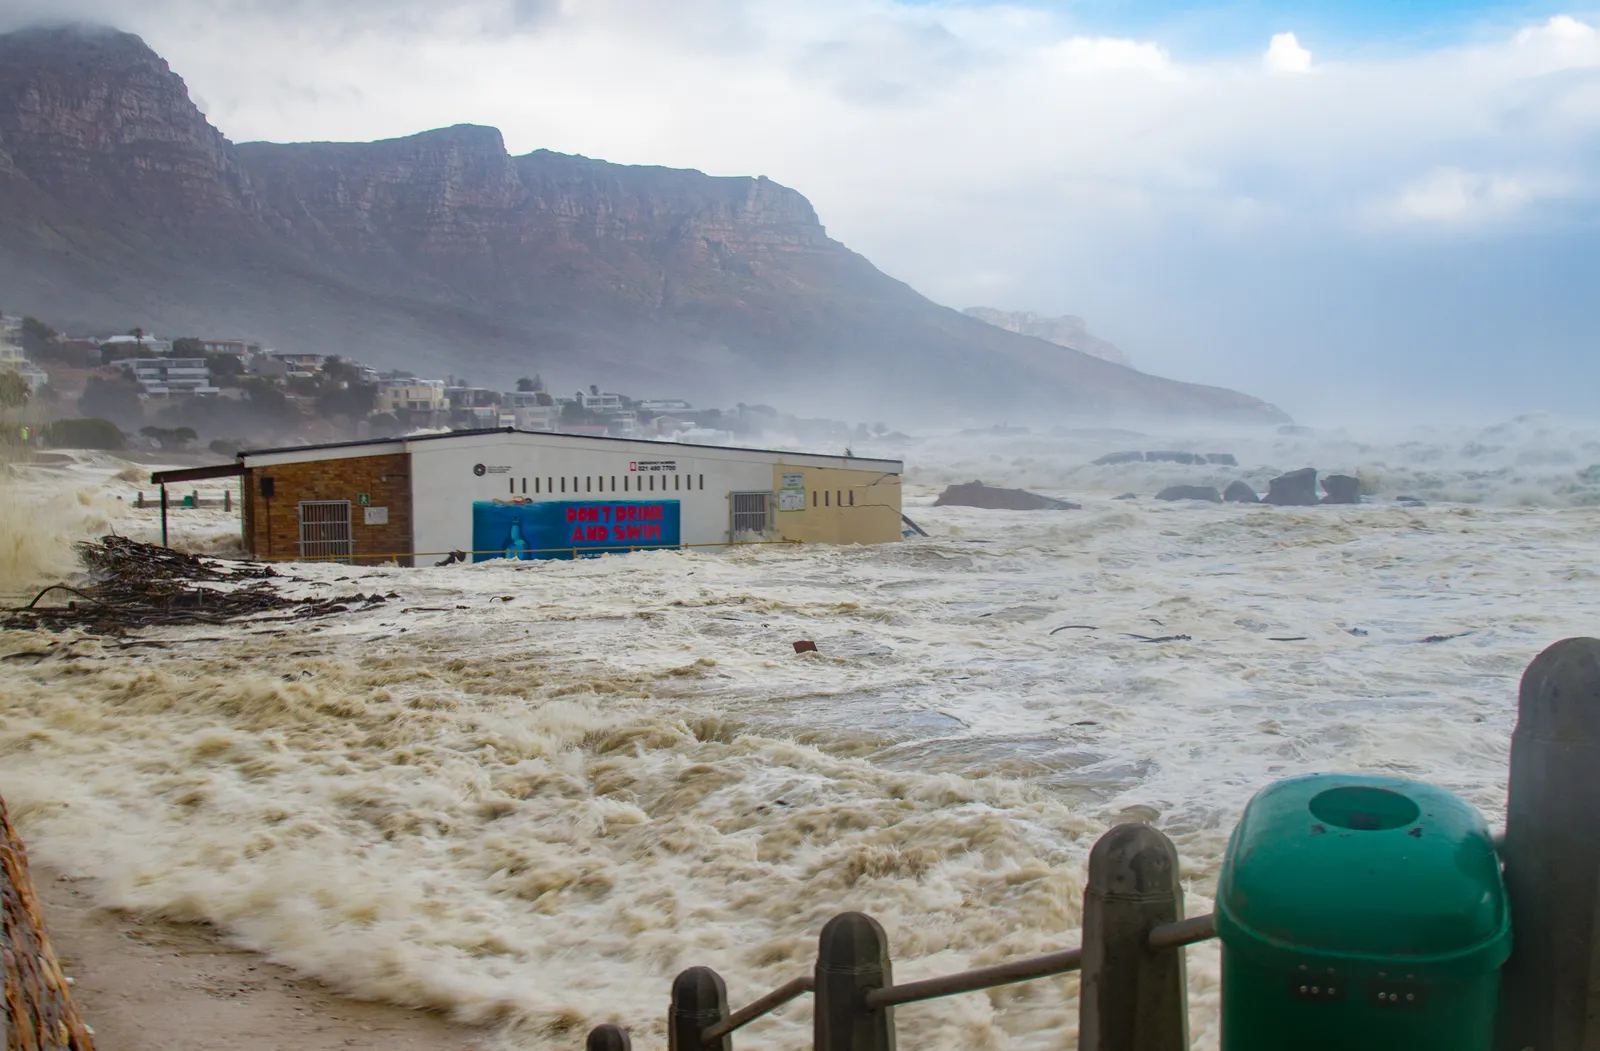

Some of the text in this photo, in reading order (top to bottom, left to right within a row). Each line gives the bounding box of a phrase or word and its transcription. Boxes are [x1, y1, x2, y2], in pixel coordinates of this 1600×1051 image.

[615, 505, 664, 522] DRINK
[571, 524, 661, 542] AND SWIM
